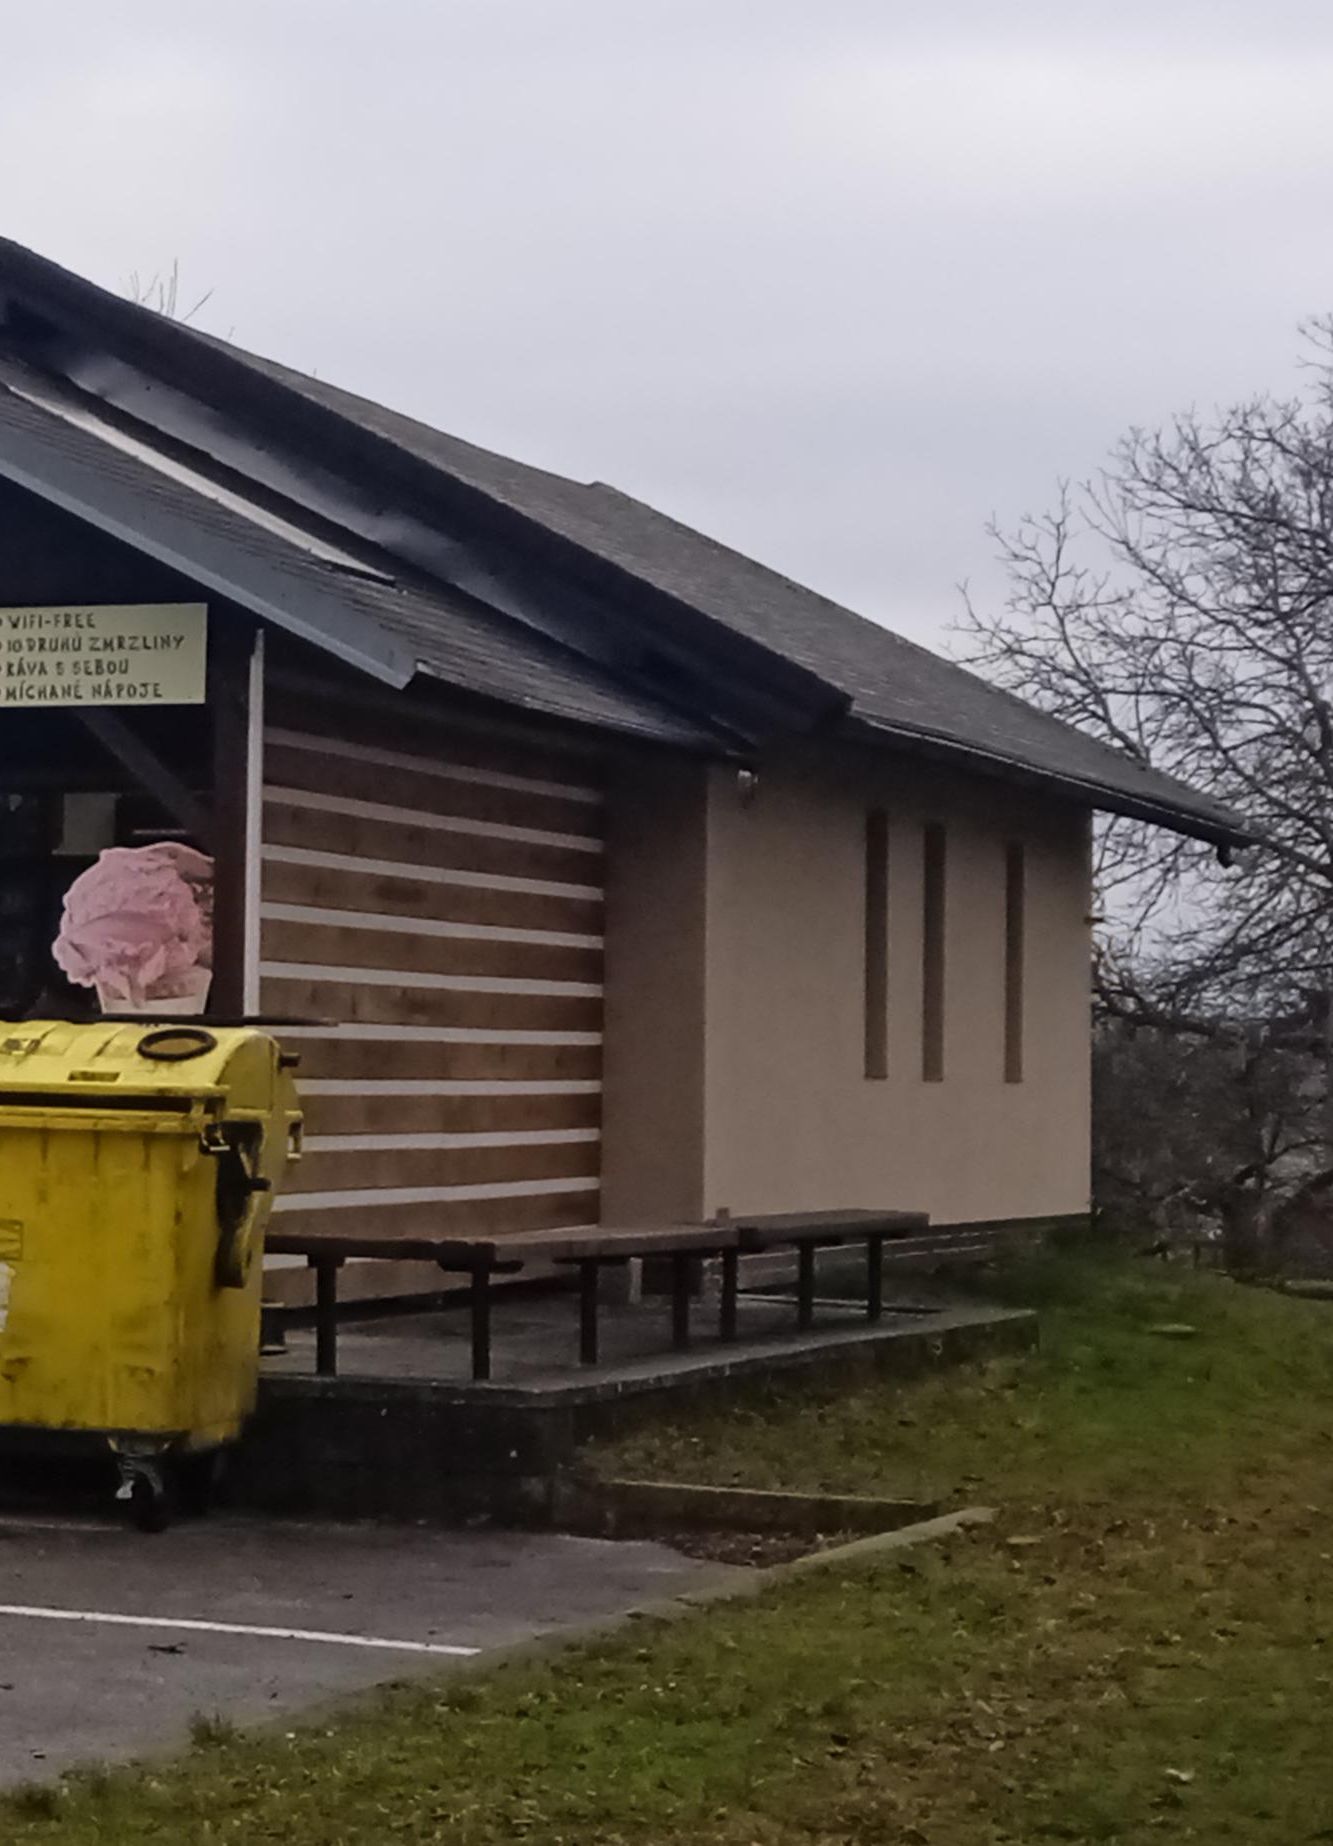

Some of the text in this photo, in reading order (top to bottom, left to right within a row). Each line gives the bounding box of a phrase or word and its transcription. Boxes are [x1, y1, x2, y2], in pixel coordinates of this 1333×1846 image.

[7, 613, 96, 629] WIFI-FREE
[88, 634, 185, 653] ZMRZLINY
[6, 657, 130, 677] KÁVA S SEBOU
[5, 678, 163, 701] MÍCHANÉ NÁPOJE
